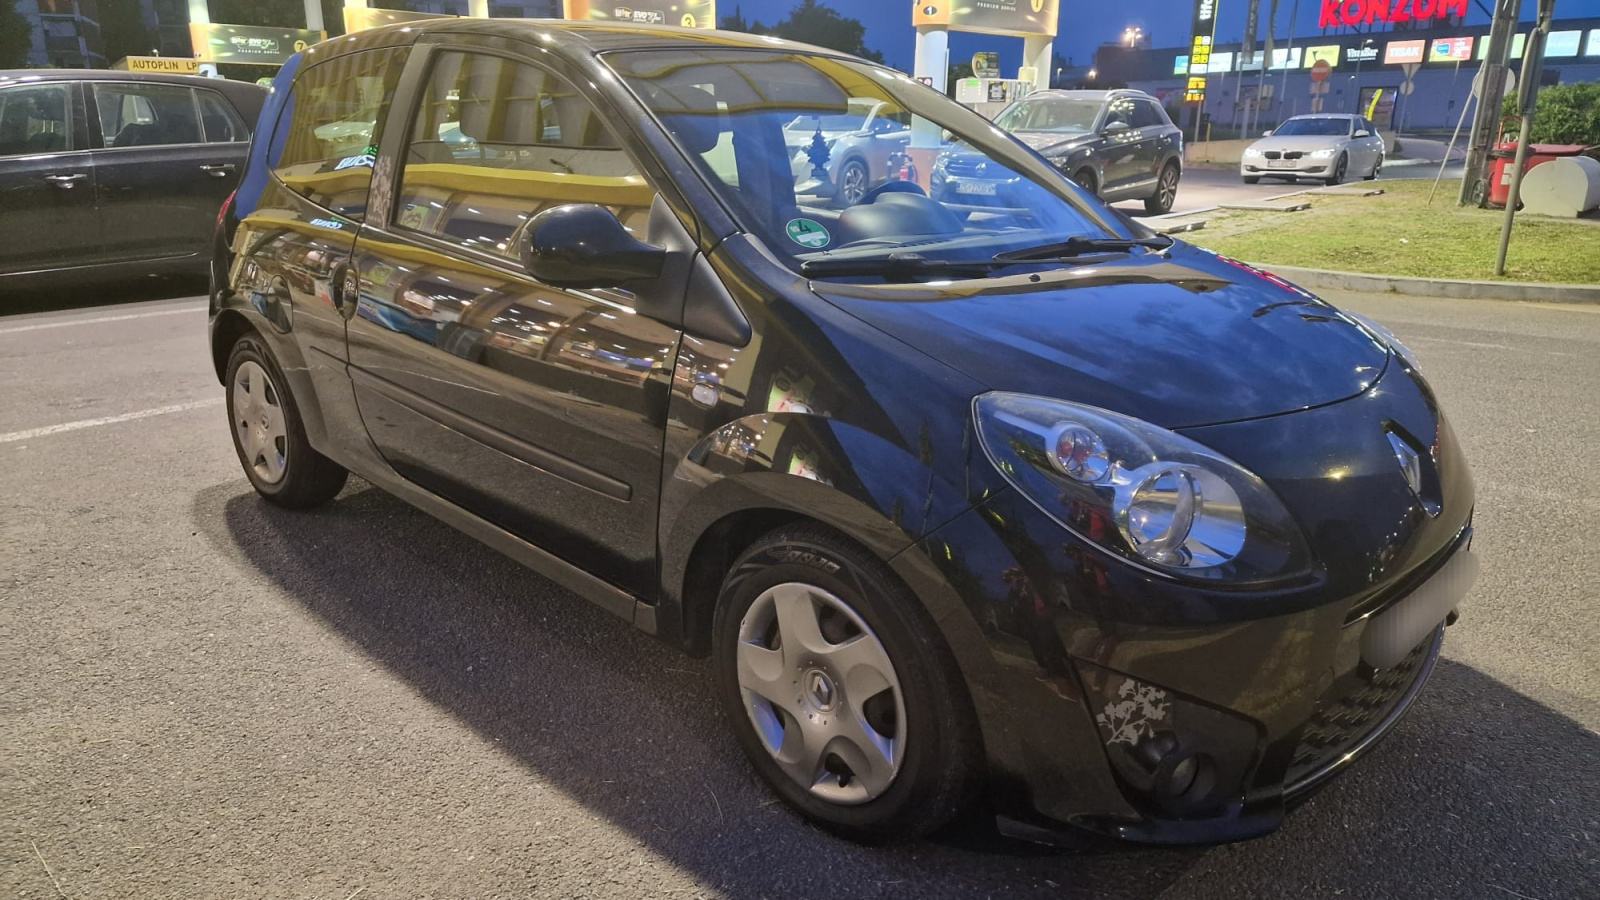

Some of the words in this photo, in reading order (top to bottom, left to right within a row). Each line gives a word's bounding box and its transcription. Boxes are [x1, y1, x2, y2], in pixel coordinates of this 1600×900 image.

[1319, 0, 1469, 28] KONZUM
[296, 42, 304, 50] 7
[132, 59, 179, 70] AUTOPLIN
[185, 61, 197, 71] LP
